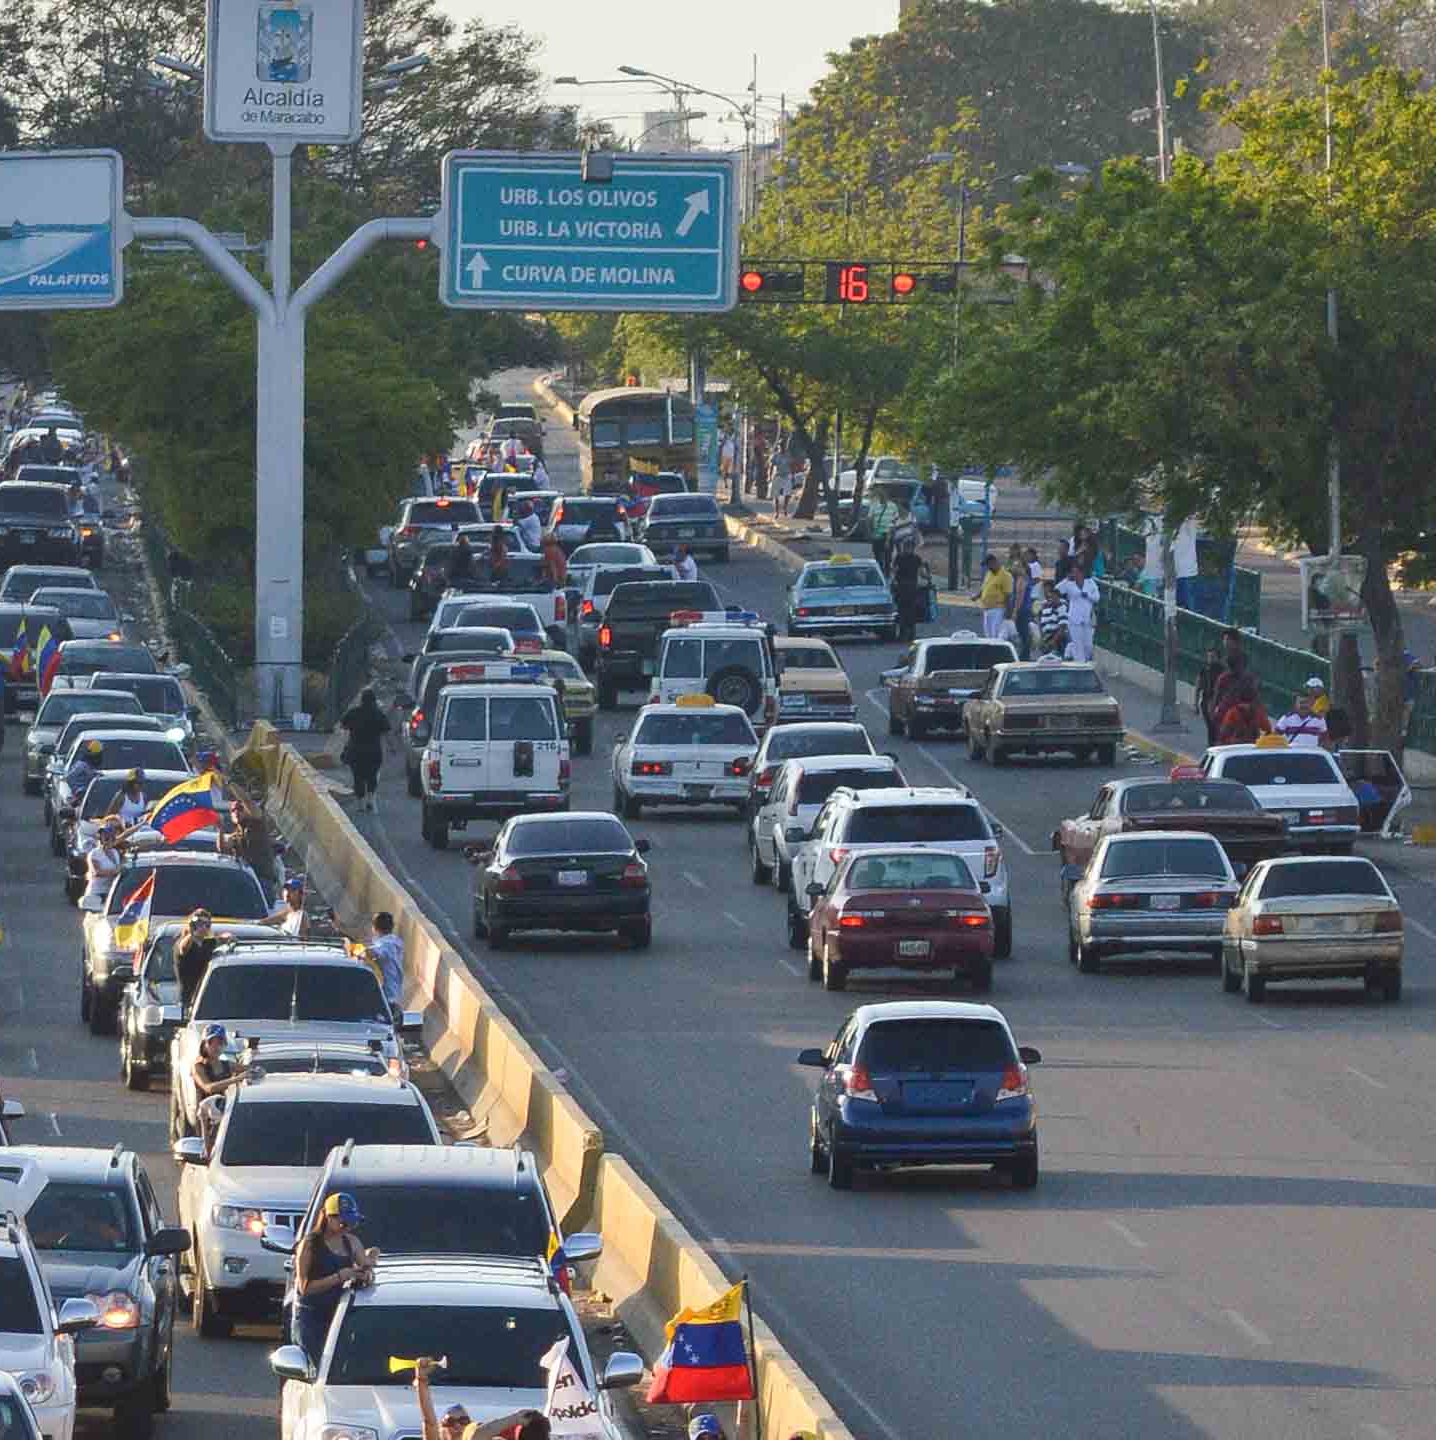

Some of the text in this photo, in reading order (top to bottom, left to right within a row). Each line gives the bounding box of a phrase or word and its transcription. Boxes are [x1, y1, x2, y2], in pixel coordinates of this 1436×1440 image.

[243, 88, 324, 107] Alcaldía
[241, 110, 259, 123] de
[500, 187, 658, 208] URB. LOS OLIVOS
[499, 219, 663, 240] URB. LA VICTORIA
[28, 273, 109, 287] PALAFITOS
[502, 265, 676, 285] CURVA DE MOLINA
[839, 266, 868, 301] 16
